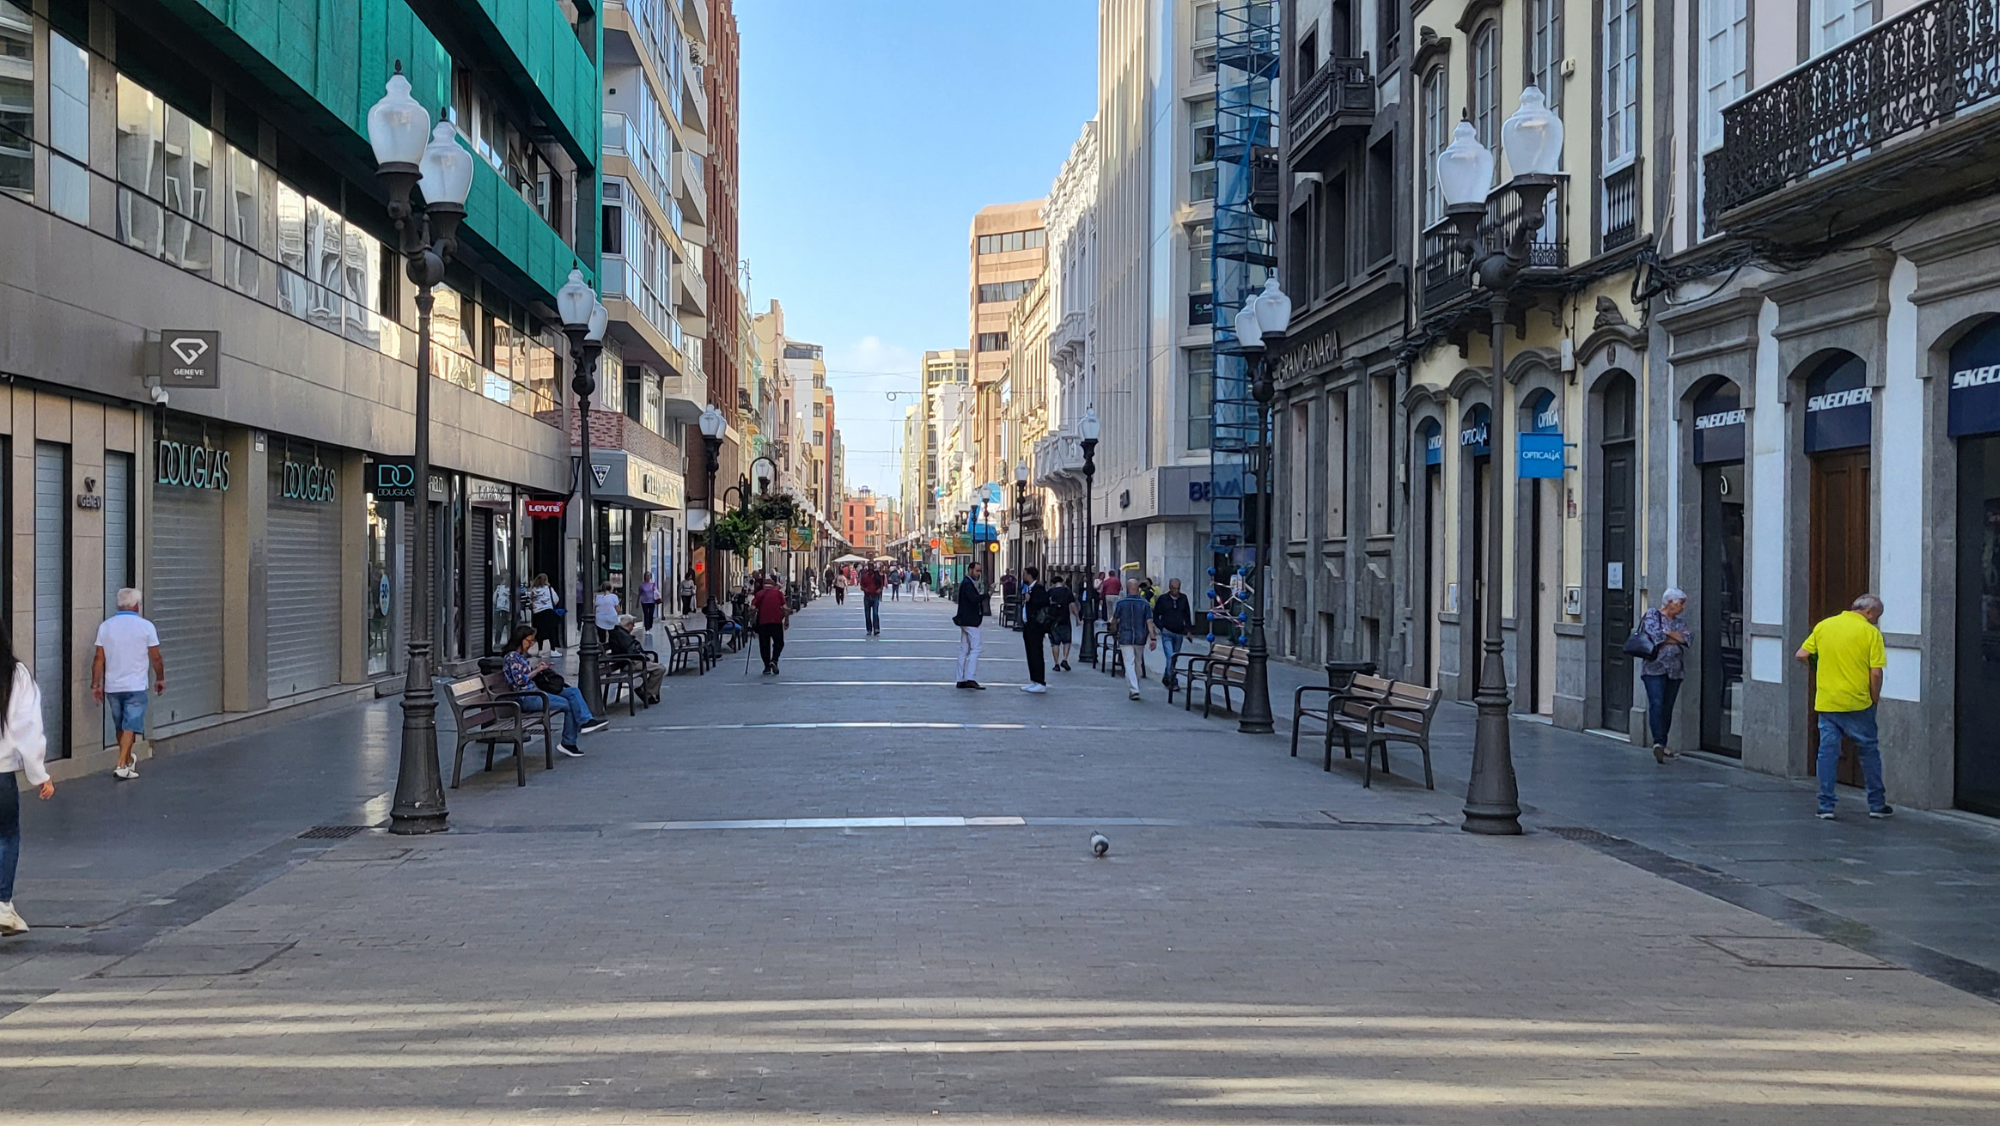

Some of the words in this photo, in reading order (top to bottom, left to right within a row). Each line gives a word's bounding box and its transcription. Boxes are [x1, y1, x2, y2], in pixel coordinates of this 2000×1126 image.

[173, 368, 205, 376] GENEVE
[1278, 348, 1300, 383] GRAN
[1301, 330, 1338, 372] CANARIA
[158, 439, 231, 491] DOUGLAS
[283, 461, 337, 503] DOUGLAS
[377, 488, 415, 497] DOUGLAS
